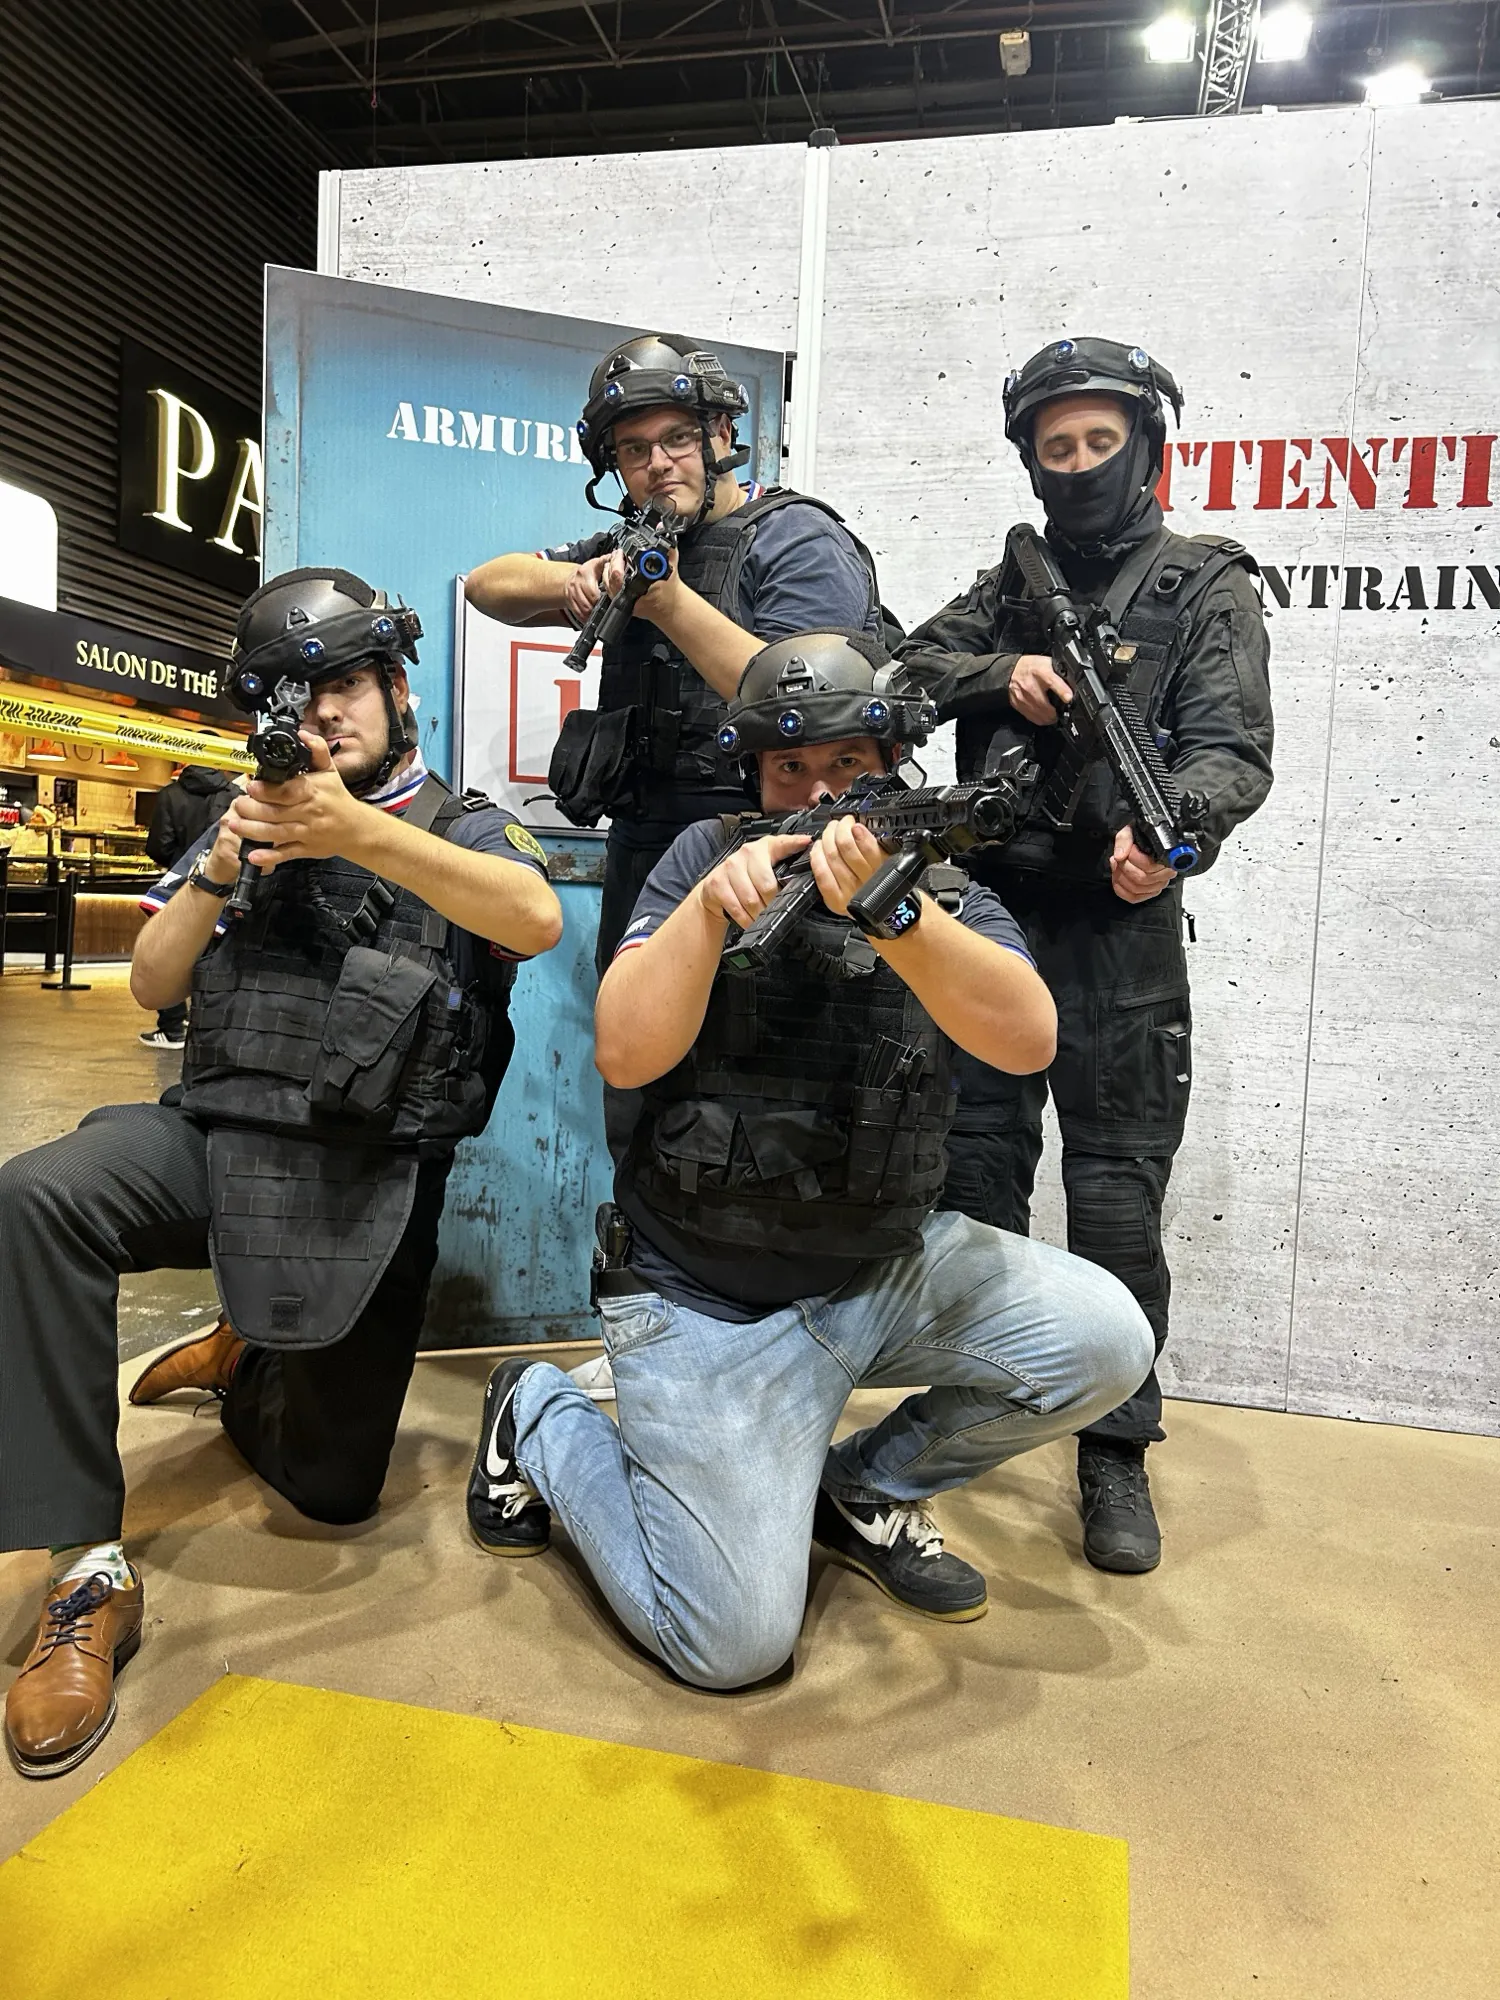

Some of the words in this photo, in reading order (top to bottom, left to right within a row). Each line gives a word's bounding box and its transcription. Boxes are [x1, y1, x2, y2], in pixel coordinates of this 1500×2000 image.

[76, 640, 148, 681] SALON
[150, 660, 178, 689] DE
[180, 669, 218, 699] THÉ
[896, 901, 915, 924] 34
